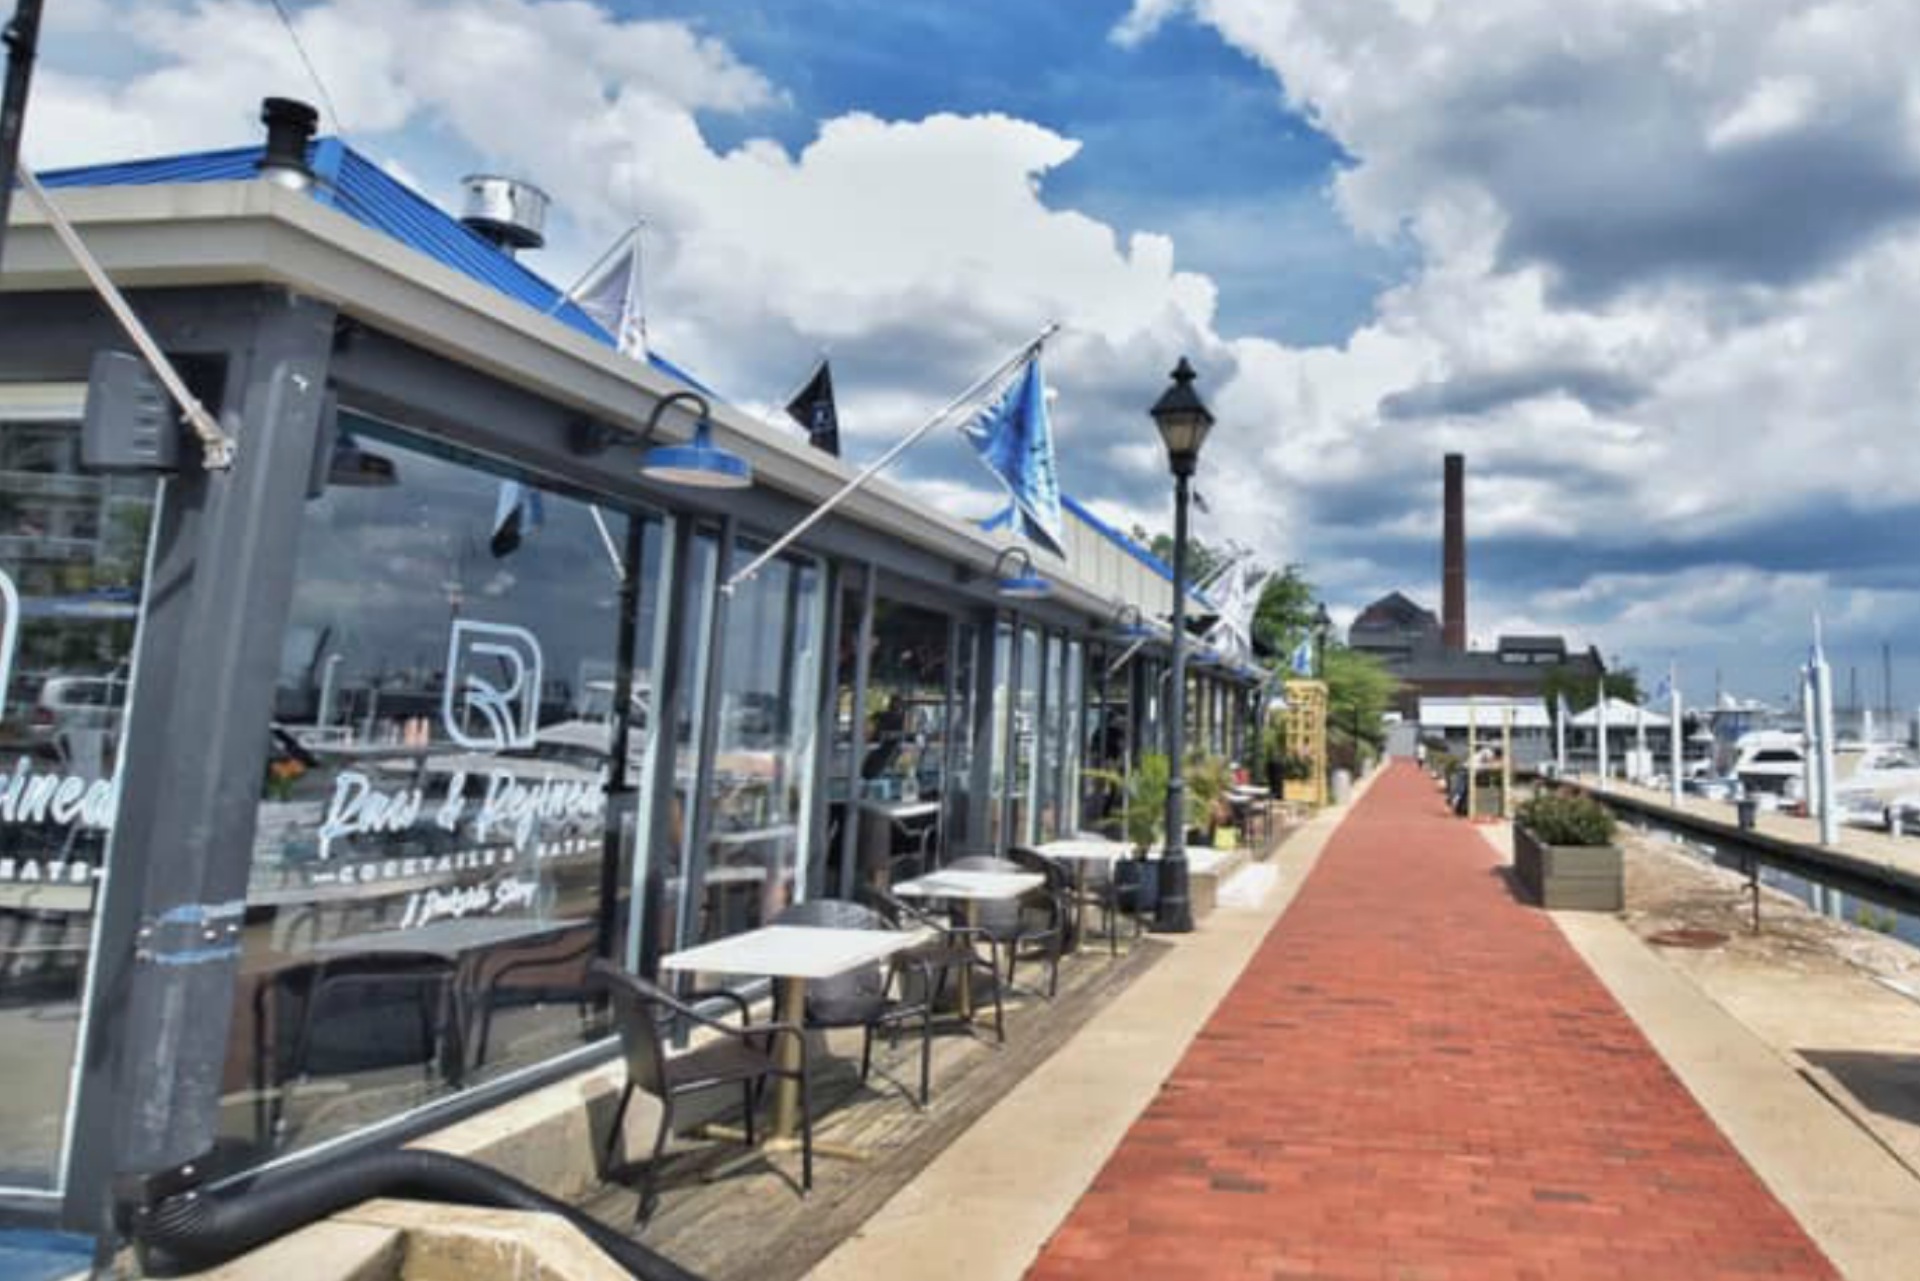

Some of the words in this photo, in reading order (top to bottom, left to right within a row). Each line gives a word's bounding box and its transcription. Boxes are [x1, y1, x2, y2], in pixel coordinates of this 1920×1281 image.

[0, 755, 117, 830] ined
[318, 770, 423, 860] Raw
[437, 770, 466, 832] &
[338, 849, 496, 884] COCKTAILS
